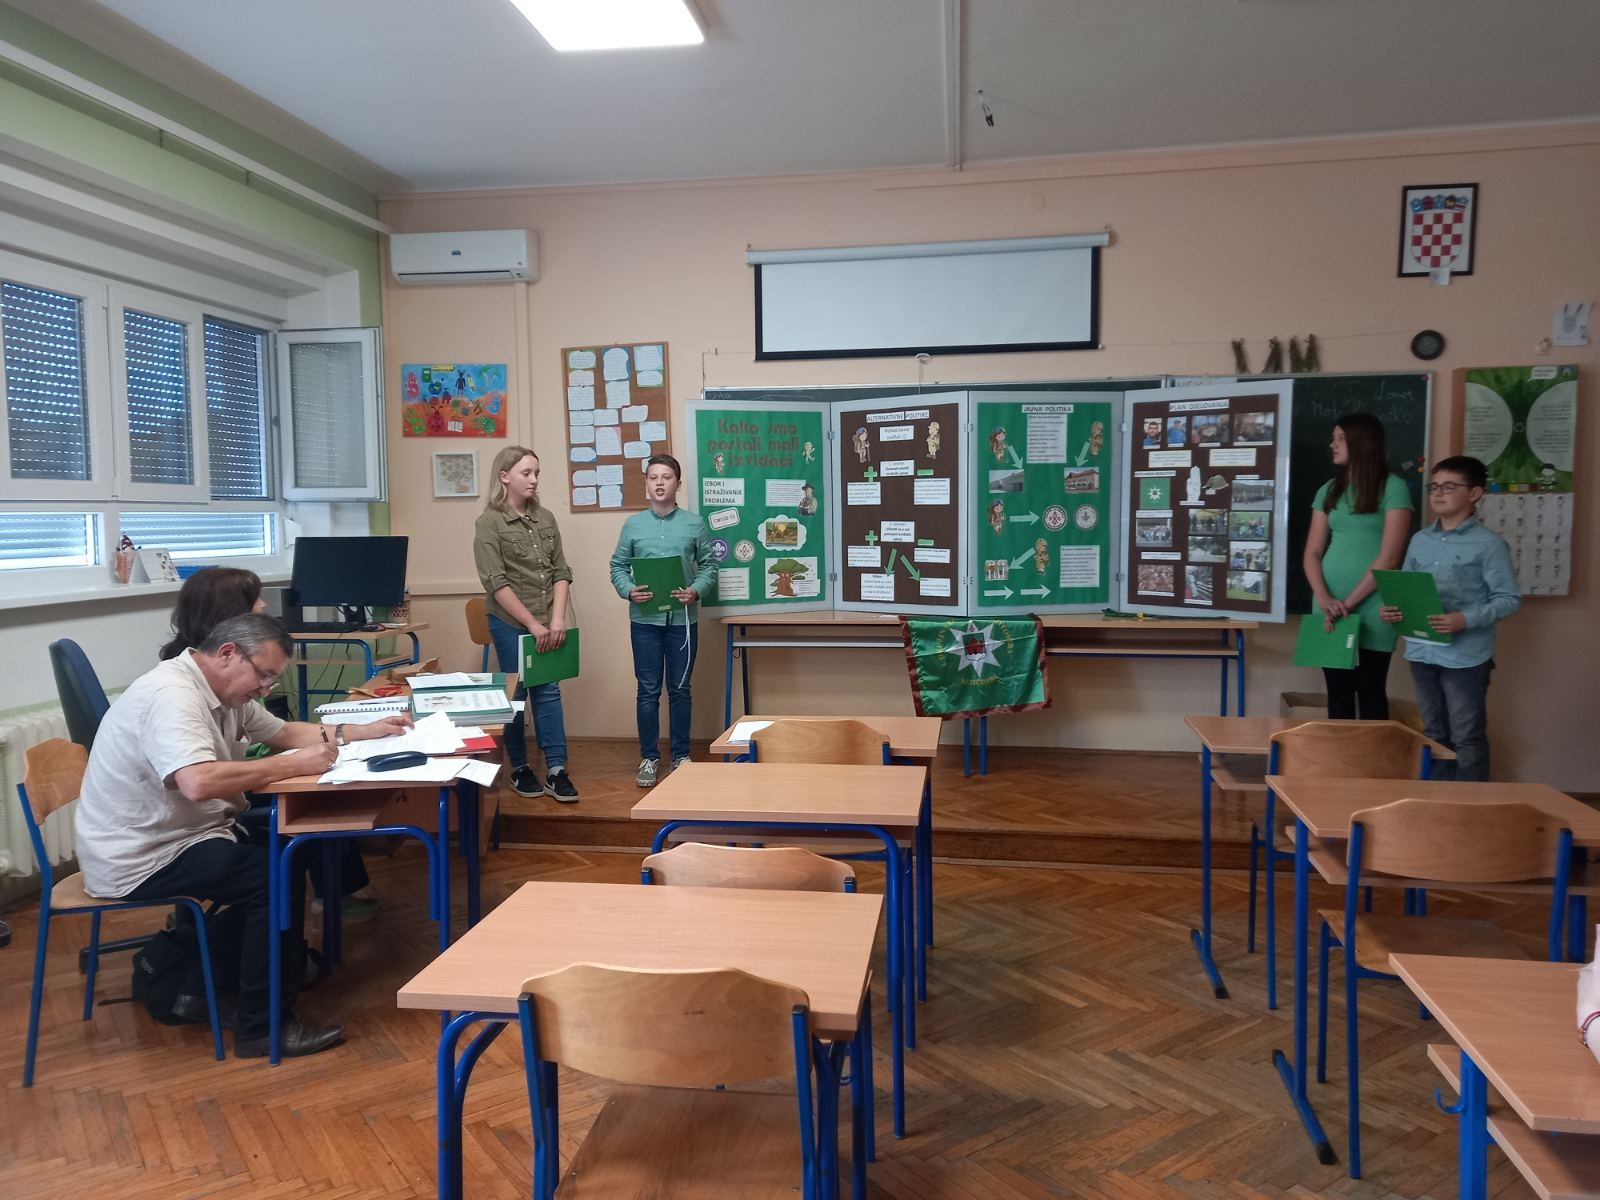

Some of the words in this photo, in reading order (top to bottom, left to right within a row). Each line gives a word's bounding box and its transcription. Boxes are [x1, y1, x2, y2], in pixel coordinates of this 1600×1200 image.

[717, 419, 759, 434] Kako
[768, 437, 799, 451] mali
[704, 488, 742, 496] ISTRAŽIVANJE
